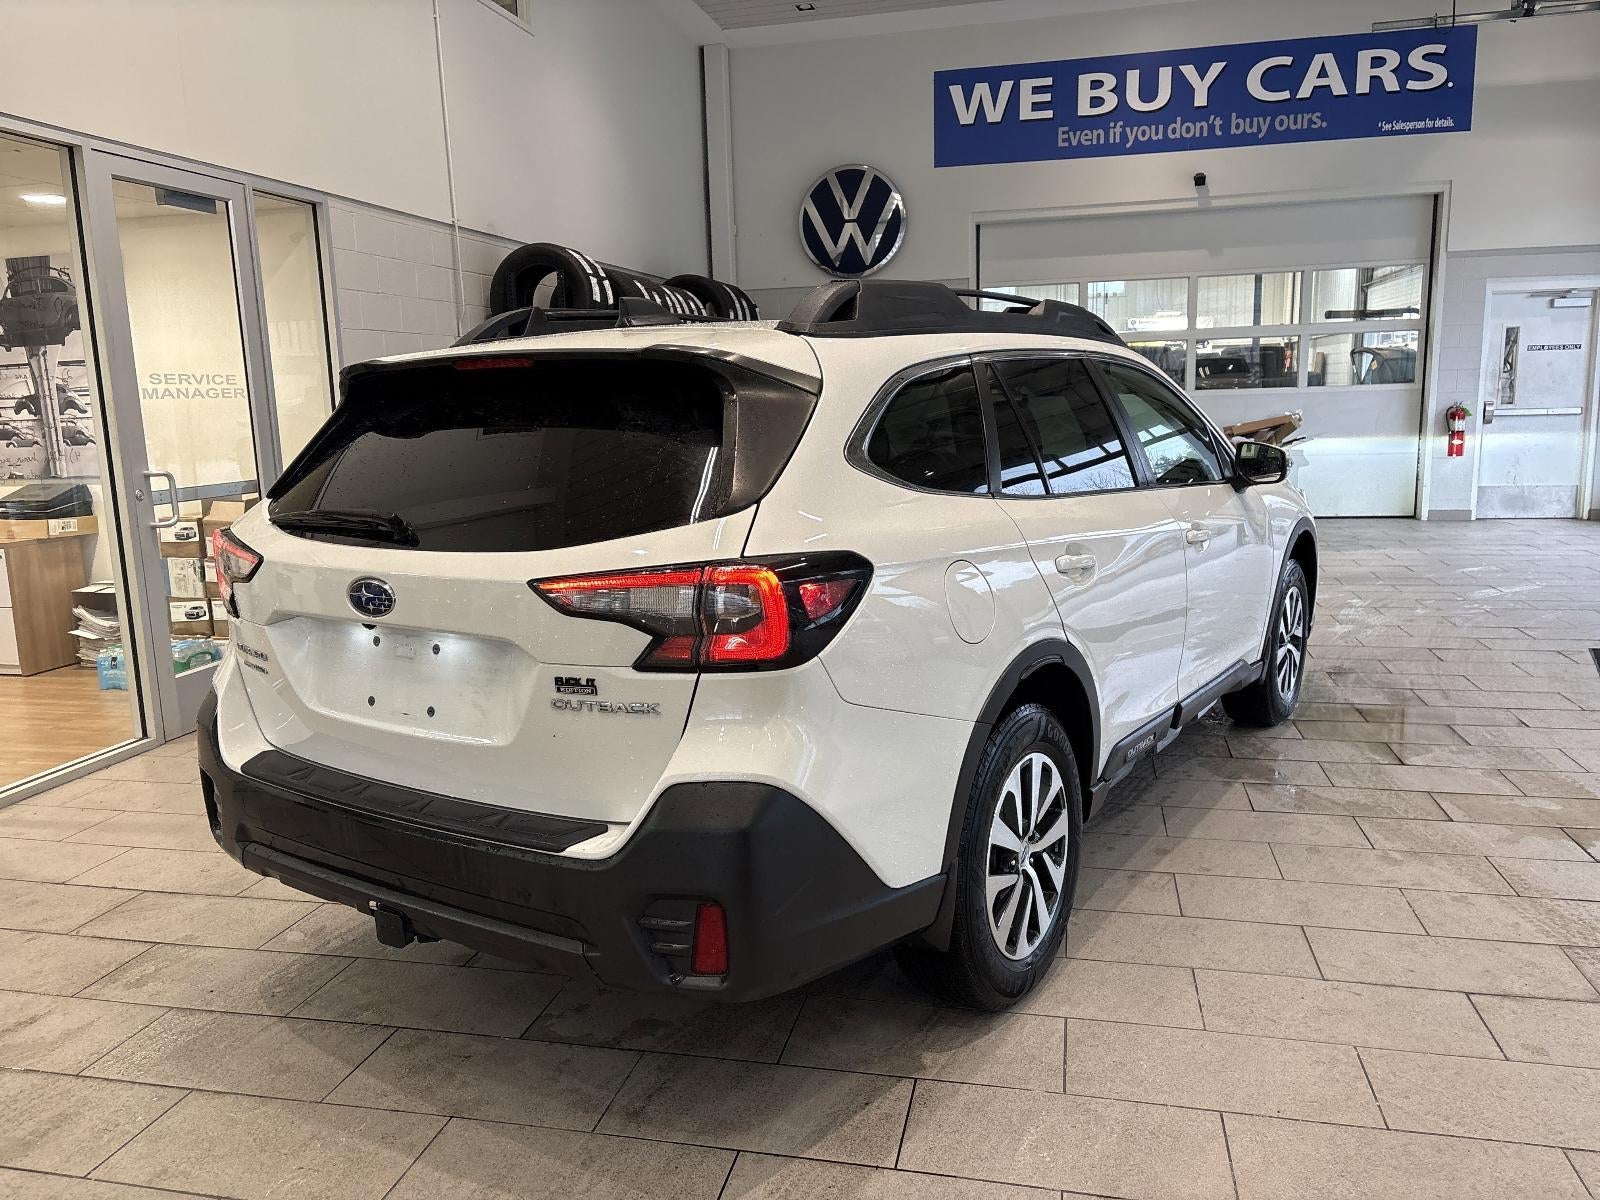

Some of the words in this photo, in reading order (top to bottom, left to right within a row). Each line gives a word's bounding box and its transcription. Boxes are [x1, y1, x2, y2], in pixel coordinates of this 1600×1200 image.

[949, 77, 1054, 125] WE
[1077, 61, 1227, 117] BUY
[1246, 43, 1454, 102] CARS.
[1057, 126, 1105, 147] Even
[1109, 121, 1124, 144] if
[1126, 124, 1163, 148] you
[1167, 115, 1223, 139] don't
[1231, 113, 1271, 139] buy
[1275, 112, 1327, 131] ours.
[1382, 120, 1392, 131] See
[1392, 119, 1425, 132] Salesperson
[1425, 117, 1434, 128] for
[149, 373, 237, 385] SERVICE
[142, 387, 246, 399] MANAGER
[551, 698, 662, 714] OUTBACK
